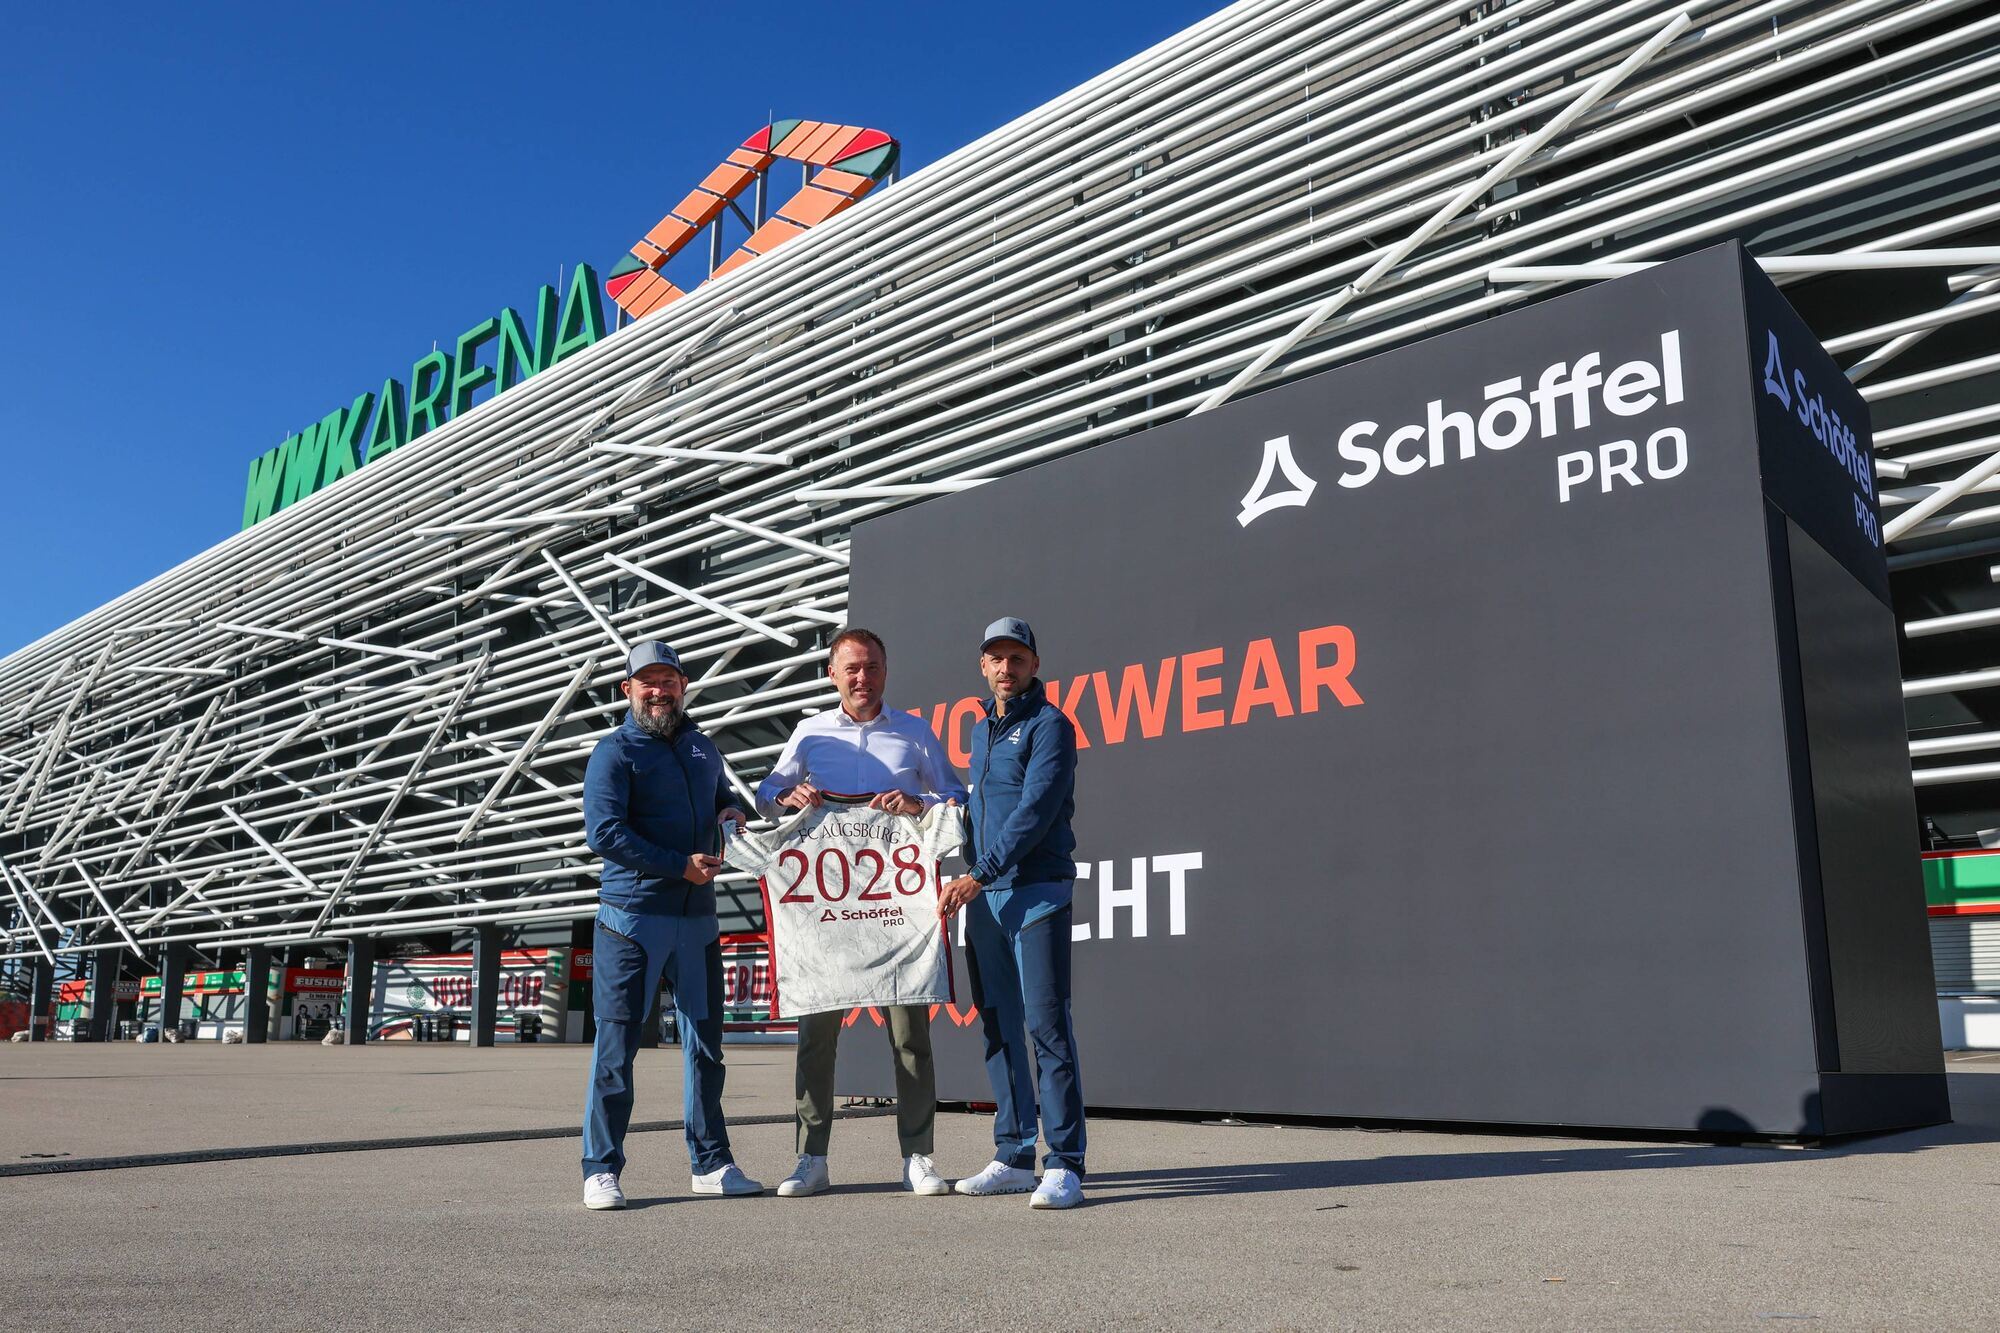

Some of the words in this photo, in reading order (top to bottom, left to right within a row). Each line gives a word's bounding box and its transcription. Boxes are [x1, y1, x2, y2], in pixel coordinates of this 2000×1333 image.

[1557, 427, 1690, 503] PRO
[1854, 492, 1879, 548] PRO
[906, 625, 1365, 769] OKWEAR
[798, 826, 819, 843] FC
[822, 822, 901, 844] AUGSBURG
[779, 844, 927, 904] 2028
[883, 917, 905, 927] PRO
